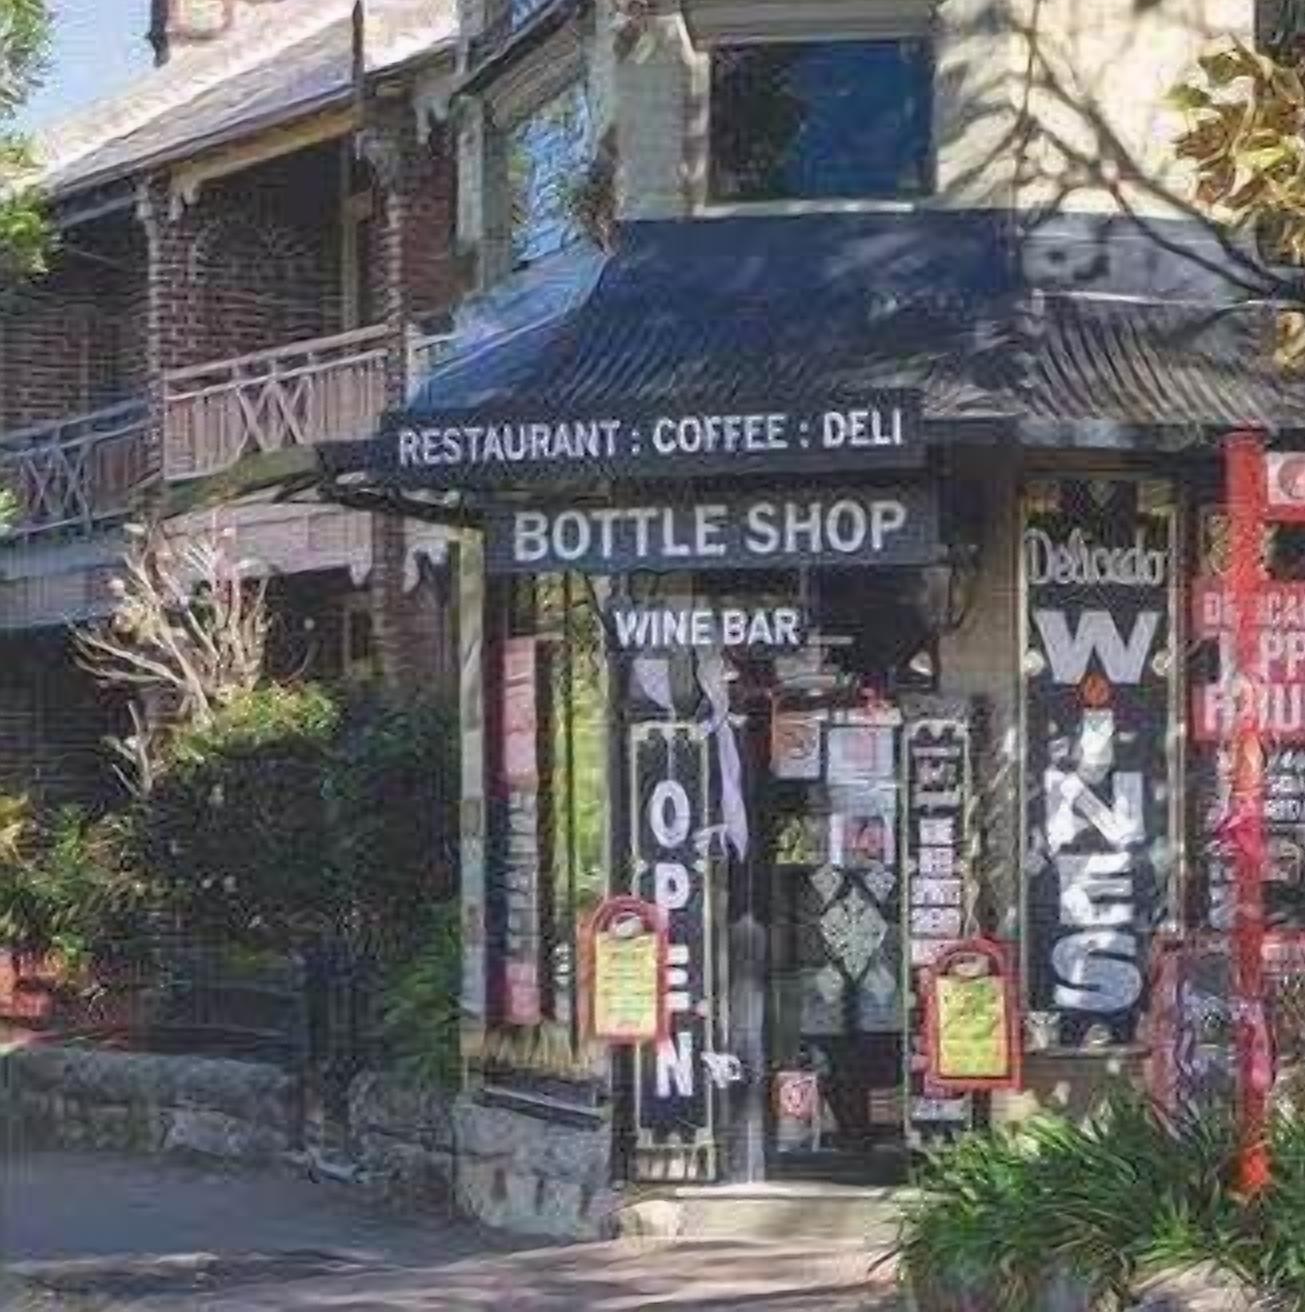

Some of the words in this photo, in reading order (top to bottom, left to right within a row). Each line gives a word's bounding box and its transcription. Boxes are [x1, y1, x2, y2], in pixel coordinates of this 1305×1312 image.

[400, 419, 620, 466] RESTAURANT
[653, 414, 788, 455] COFFEE
[823, 408, 903, 448] DELI
[513, 504, 728, 562] BOTTLE
[745, 499, 906, 554] SHOP
[615, 609, 713, 646] WINE
[723, 608, 799, 645] BAR
[650, 779, 694, 1097] OPEN
